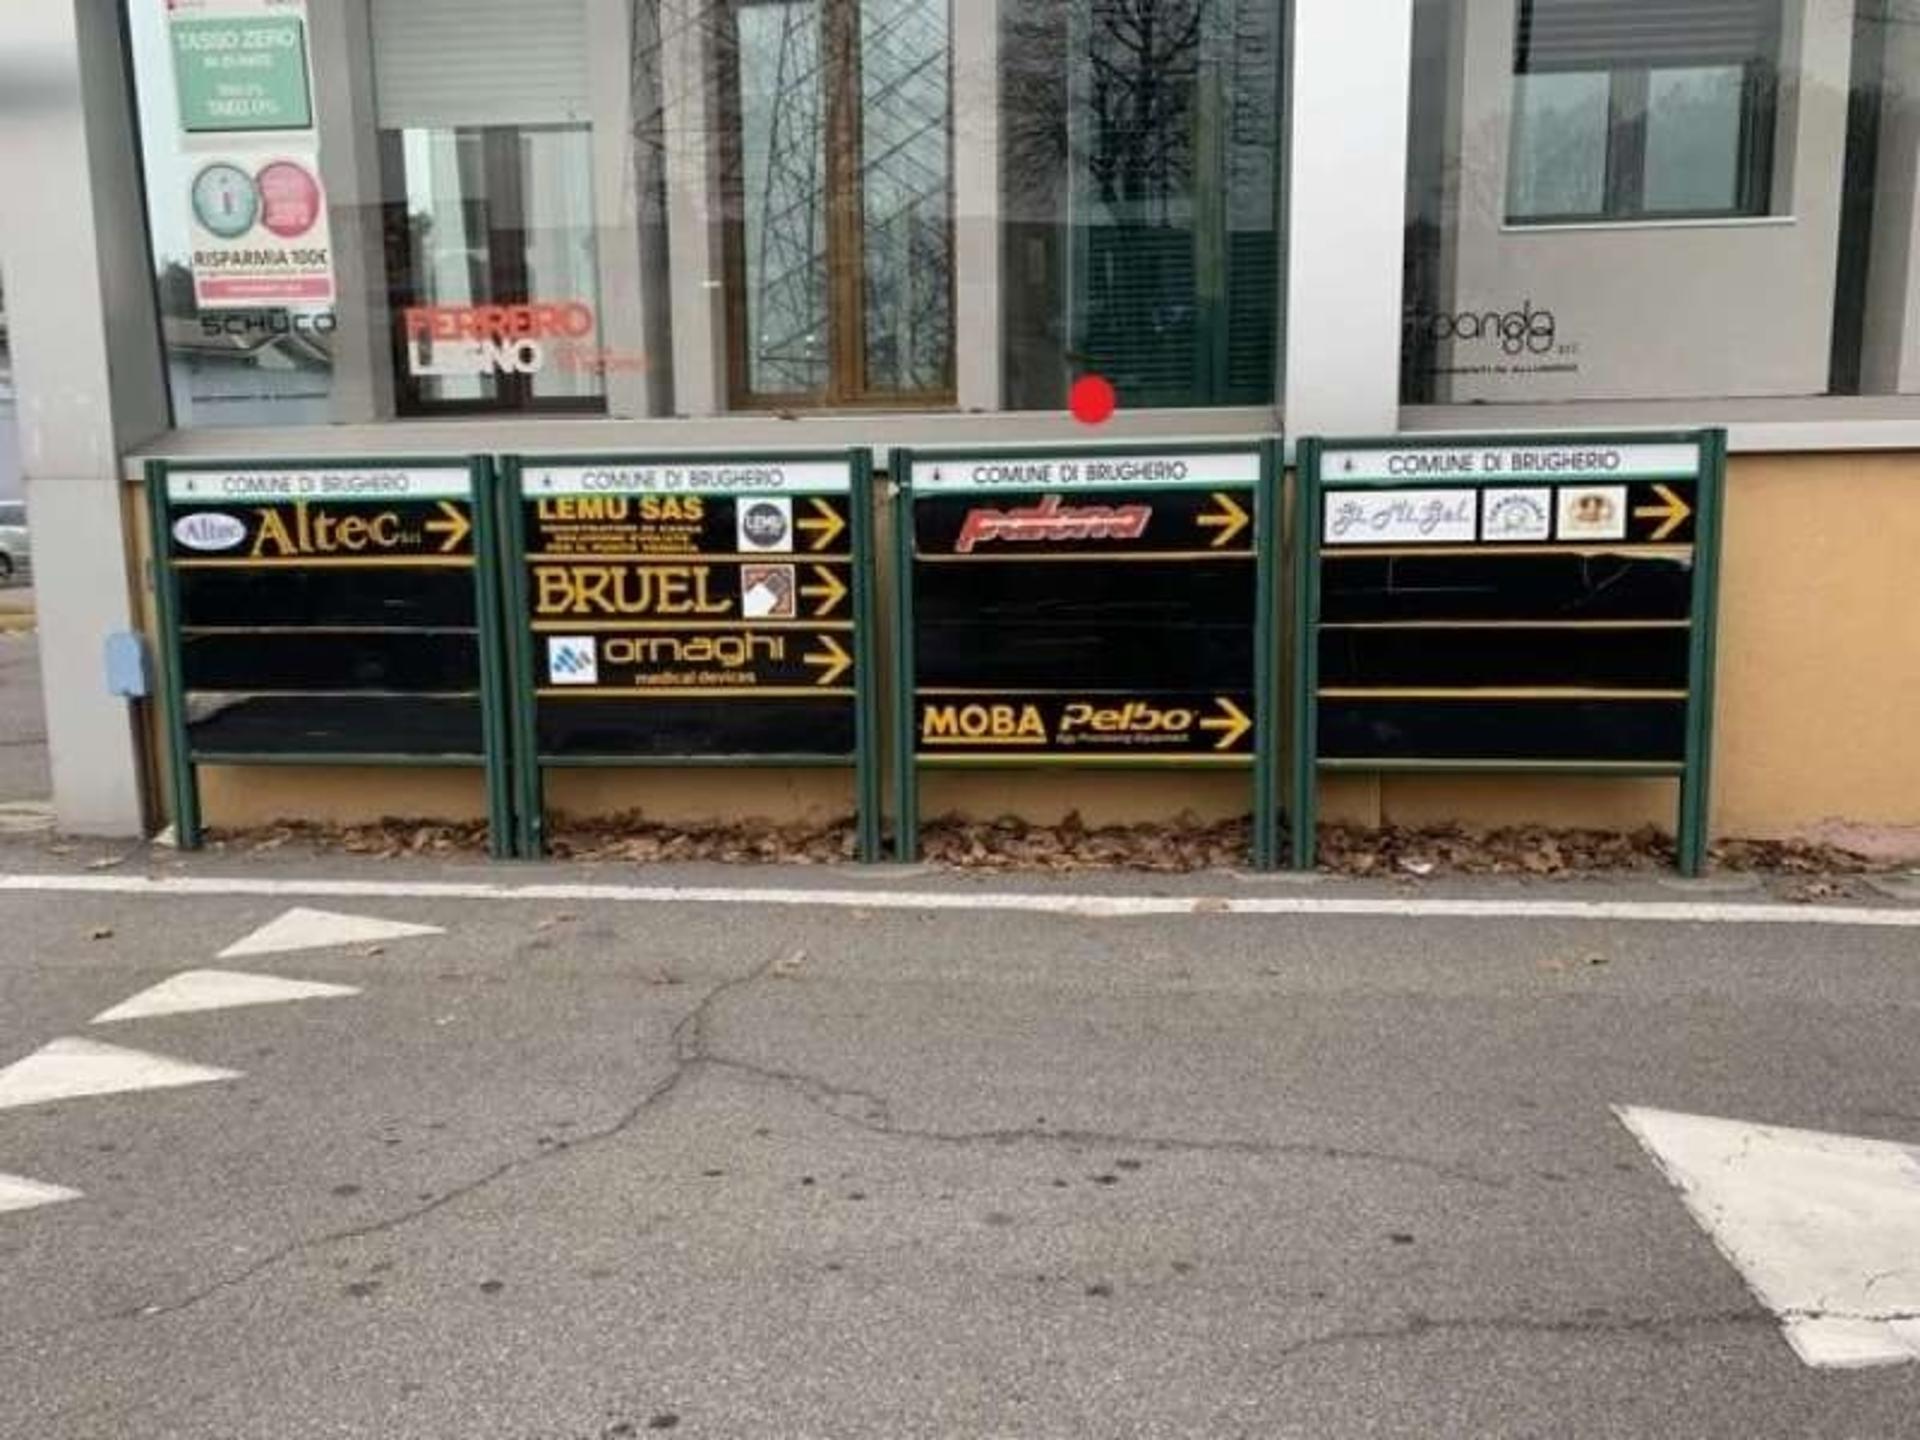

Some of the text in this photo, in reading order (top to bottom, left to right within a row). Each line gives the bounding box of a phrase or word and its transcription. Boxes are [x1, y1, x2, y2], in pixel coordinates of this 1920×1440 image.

[404, 303, 593, 339] FERRERO
[972, 461, 1189, 484] COMUNE DI BRUGHERIO
[1388, 450, 1621, 475] COMUNE DI BRUGHERIO
[222, 473, 410, 493] COMUNE DI BRUGHERIO
[582, 468, 785, 490] COMUNE DI BRUGHERIO
[537, 496, 704, 520] LEMU SAS
[252, 500, 399, 556] Altec
[533, 566, 733, 613] BRUEL
[635, 670, 756, 685] medical devices
[922, 704, 1047, 737] MOBA
